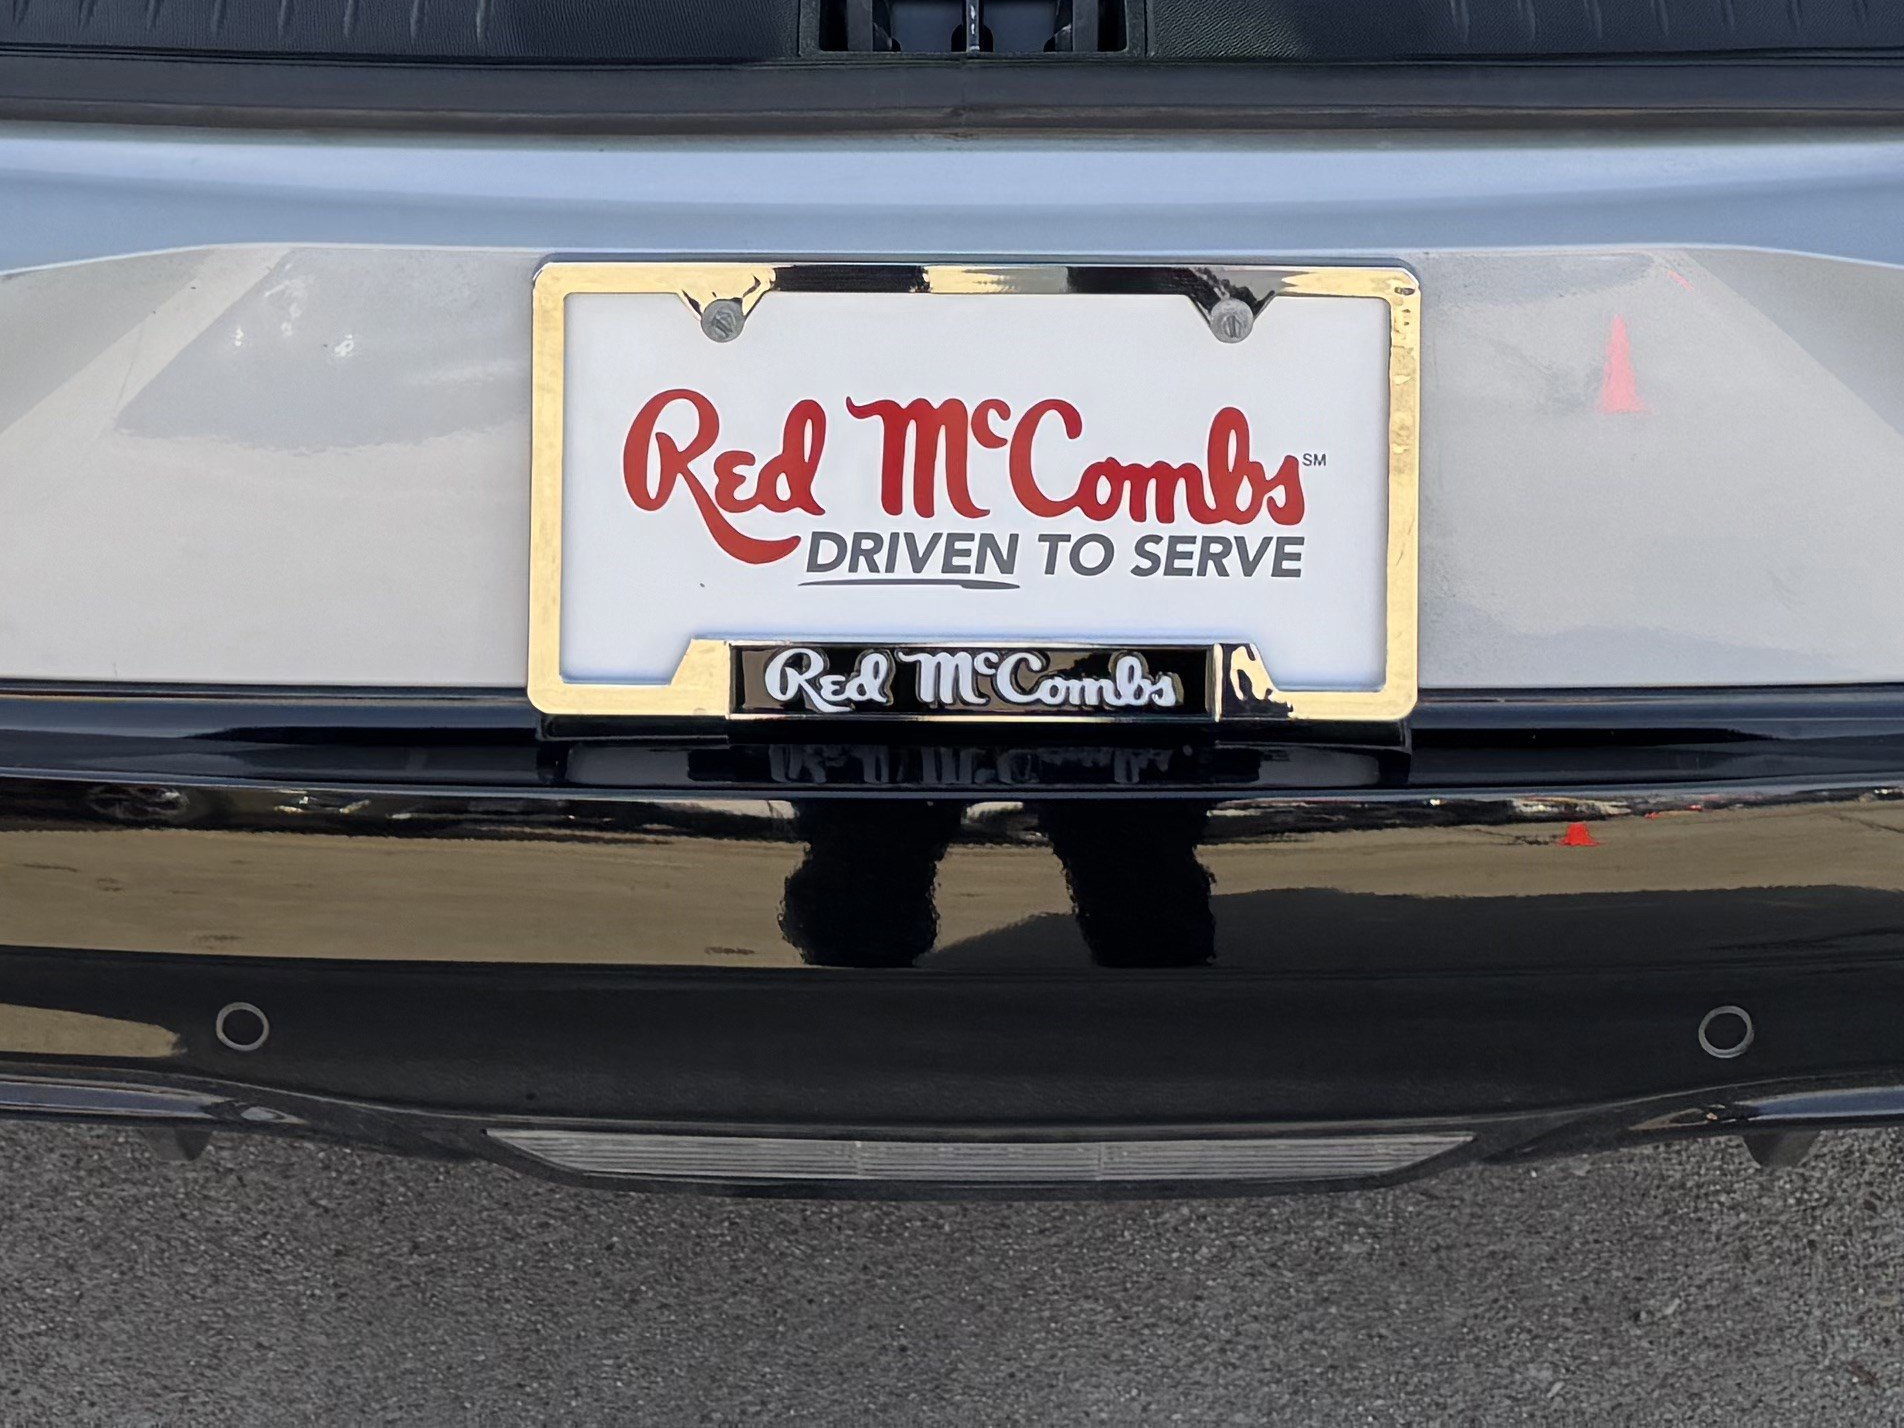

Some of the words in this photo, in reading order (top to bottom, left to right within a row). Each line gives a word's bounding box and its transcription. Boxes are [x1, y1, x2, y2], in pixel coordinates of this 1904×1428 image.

[623, 388, 827, 565] Red
[846, 398, 1305, 526] McCombs
[806, 531, 1020, 576] DRIVEN
[1037, 533, 1116, 577] TO
[1131, 534, 1306, 578] SERVE
[764, 647, 889, 712] Red
[898, 650, 1177, 708] McCombs
